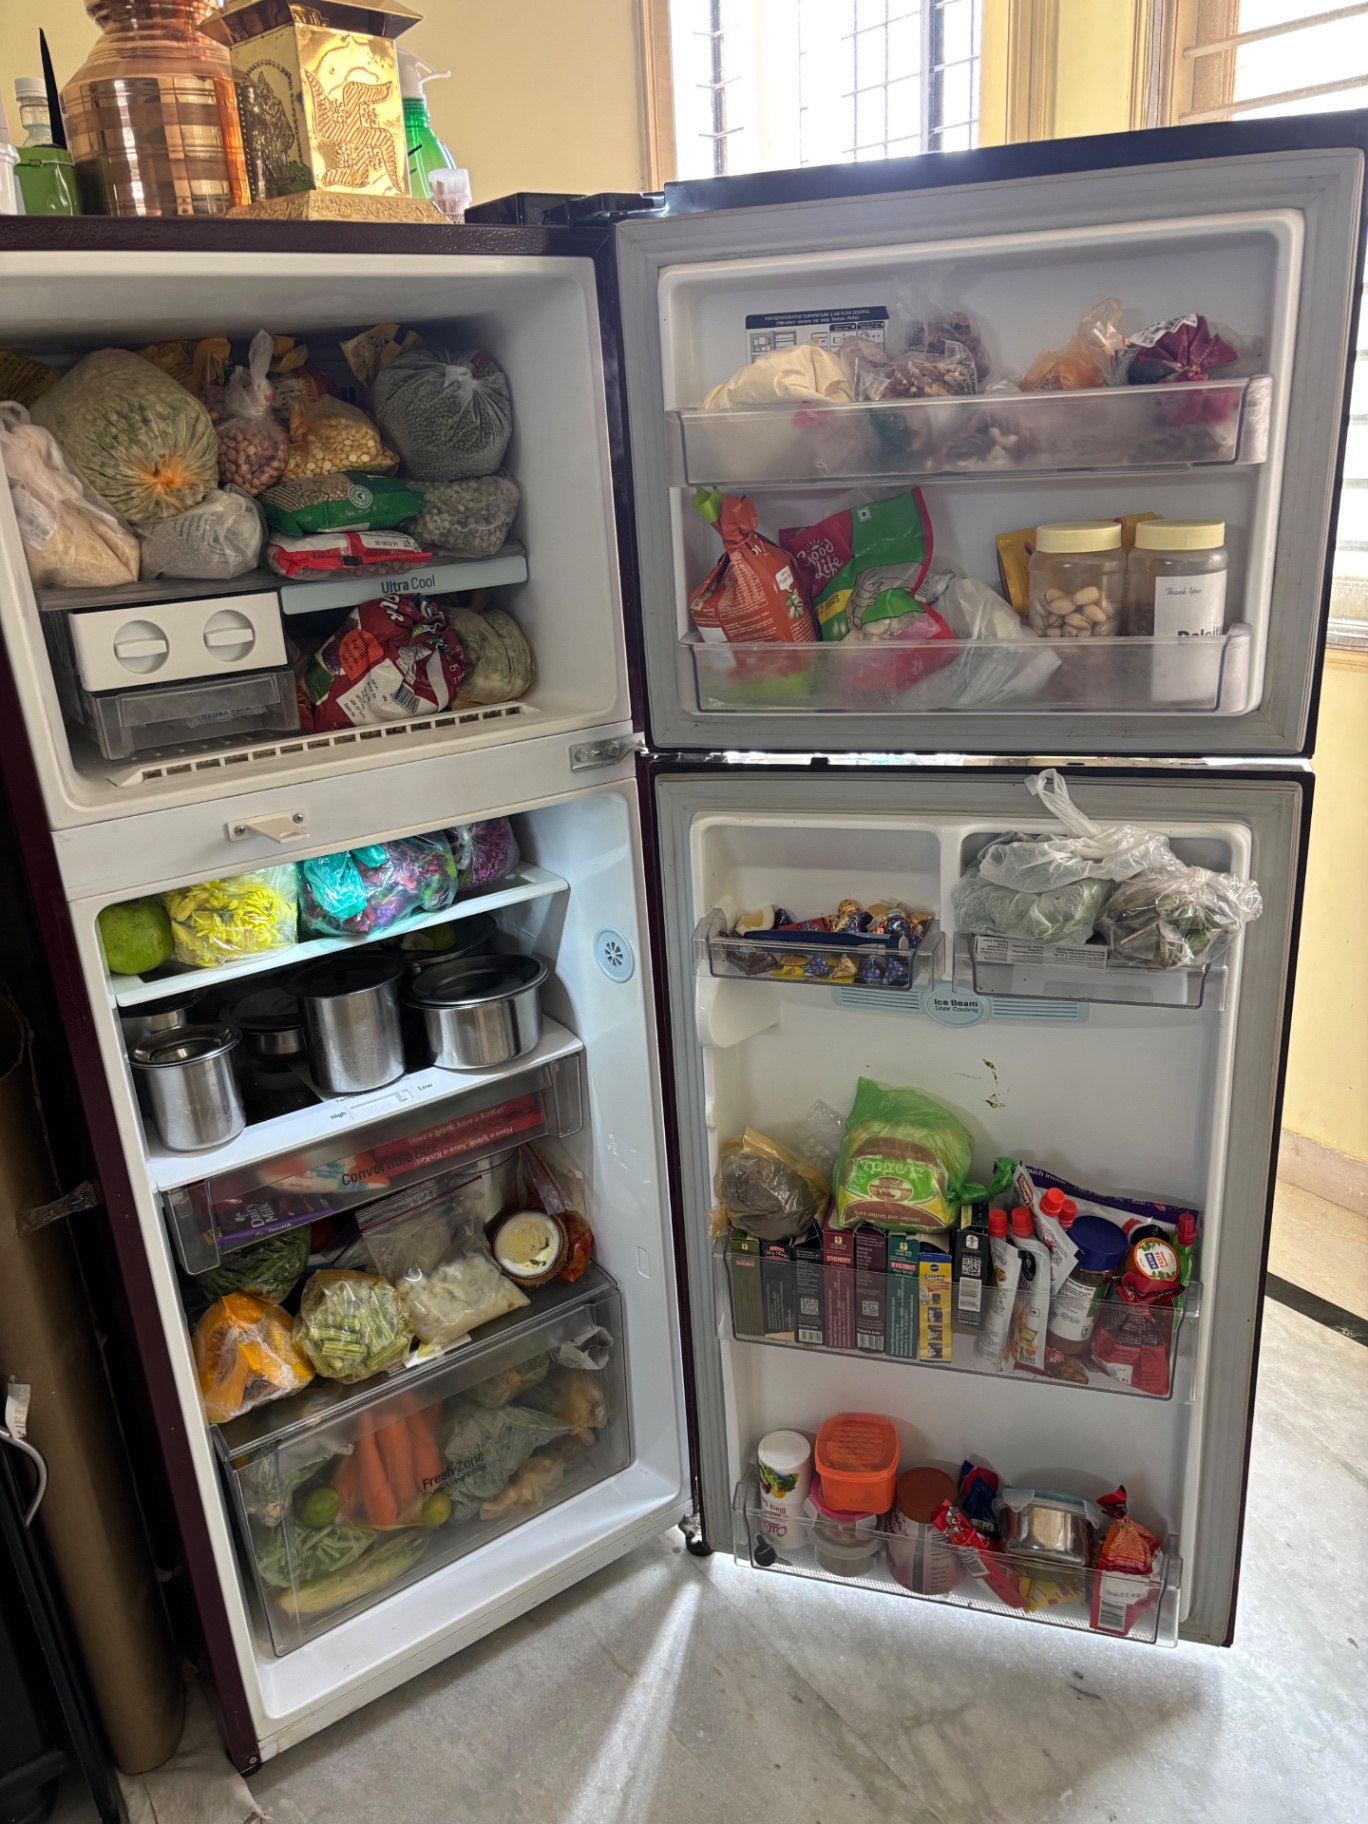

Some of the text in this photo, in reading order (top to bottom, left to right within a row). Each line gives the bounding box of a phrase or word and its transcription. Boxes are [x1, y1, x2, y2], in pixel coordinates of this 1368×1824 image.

[797, 538, 844, 580] Good Life
[381, 575, 436, 594] Ultra Cool
[1165, 587, 1202, 596] Thank You
[330, 1111, 347, 1120] High
[494, 1127, 513, 1137] Have
[341, 1145, 438, 1186] Convertible Box
[246, 1204, 265, 1228] Dairy
[259, 1201, 278, 1223] Milk
[422, 1452, 484, 1490] Fresh Zone
